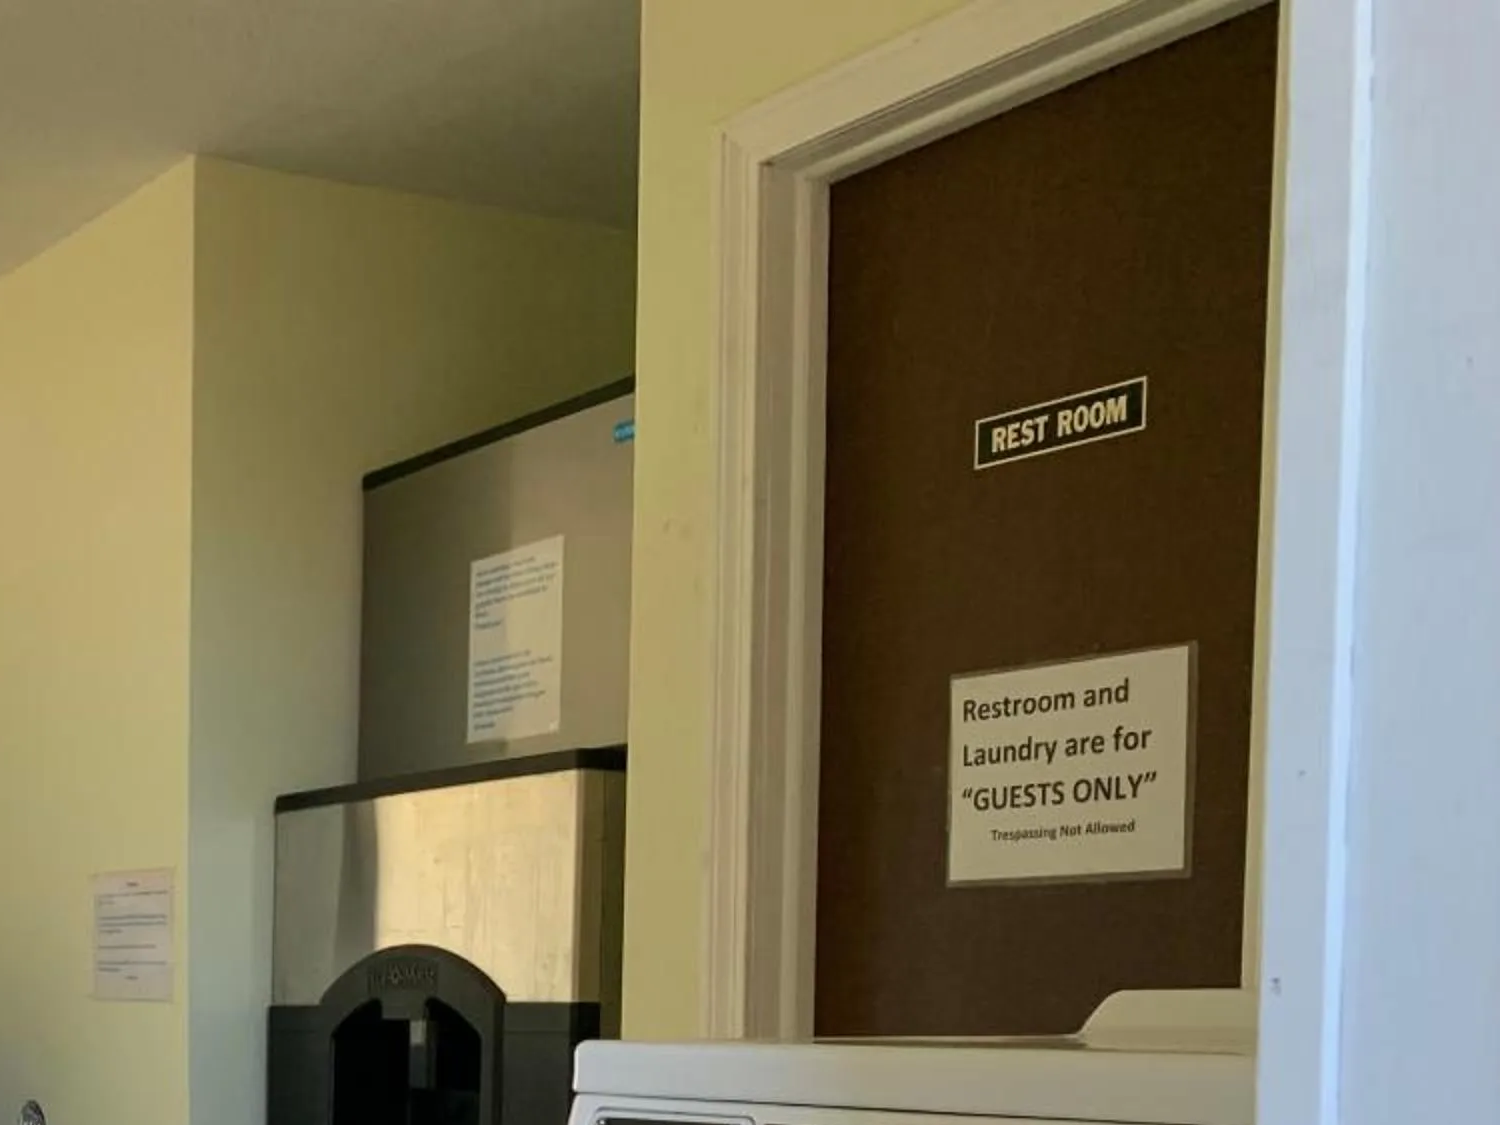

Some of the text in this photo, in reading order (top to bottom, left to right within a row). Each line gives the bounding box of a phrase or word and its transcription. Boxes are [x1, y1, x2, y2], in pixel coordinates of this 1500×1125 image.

[991, 394, 1128, 453] REST ROOM
[963, 677, 1130, 722] Restroom and
[963, 725, 1152, 767] Laundry are for
[992, 819, 1135, 842] Trespassing Not Allowed
